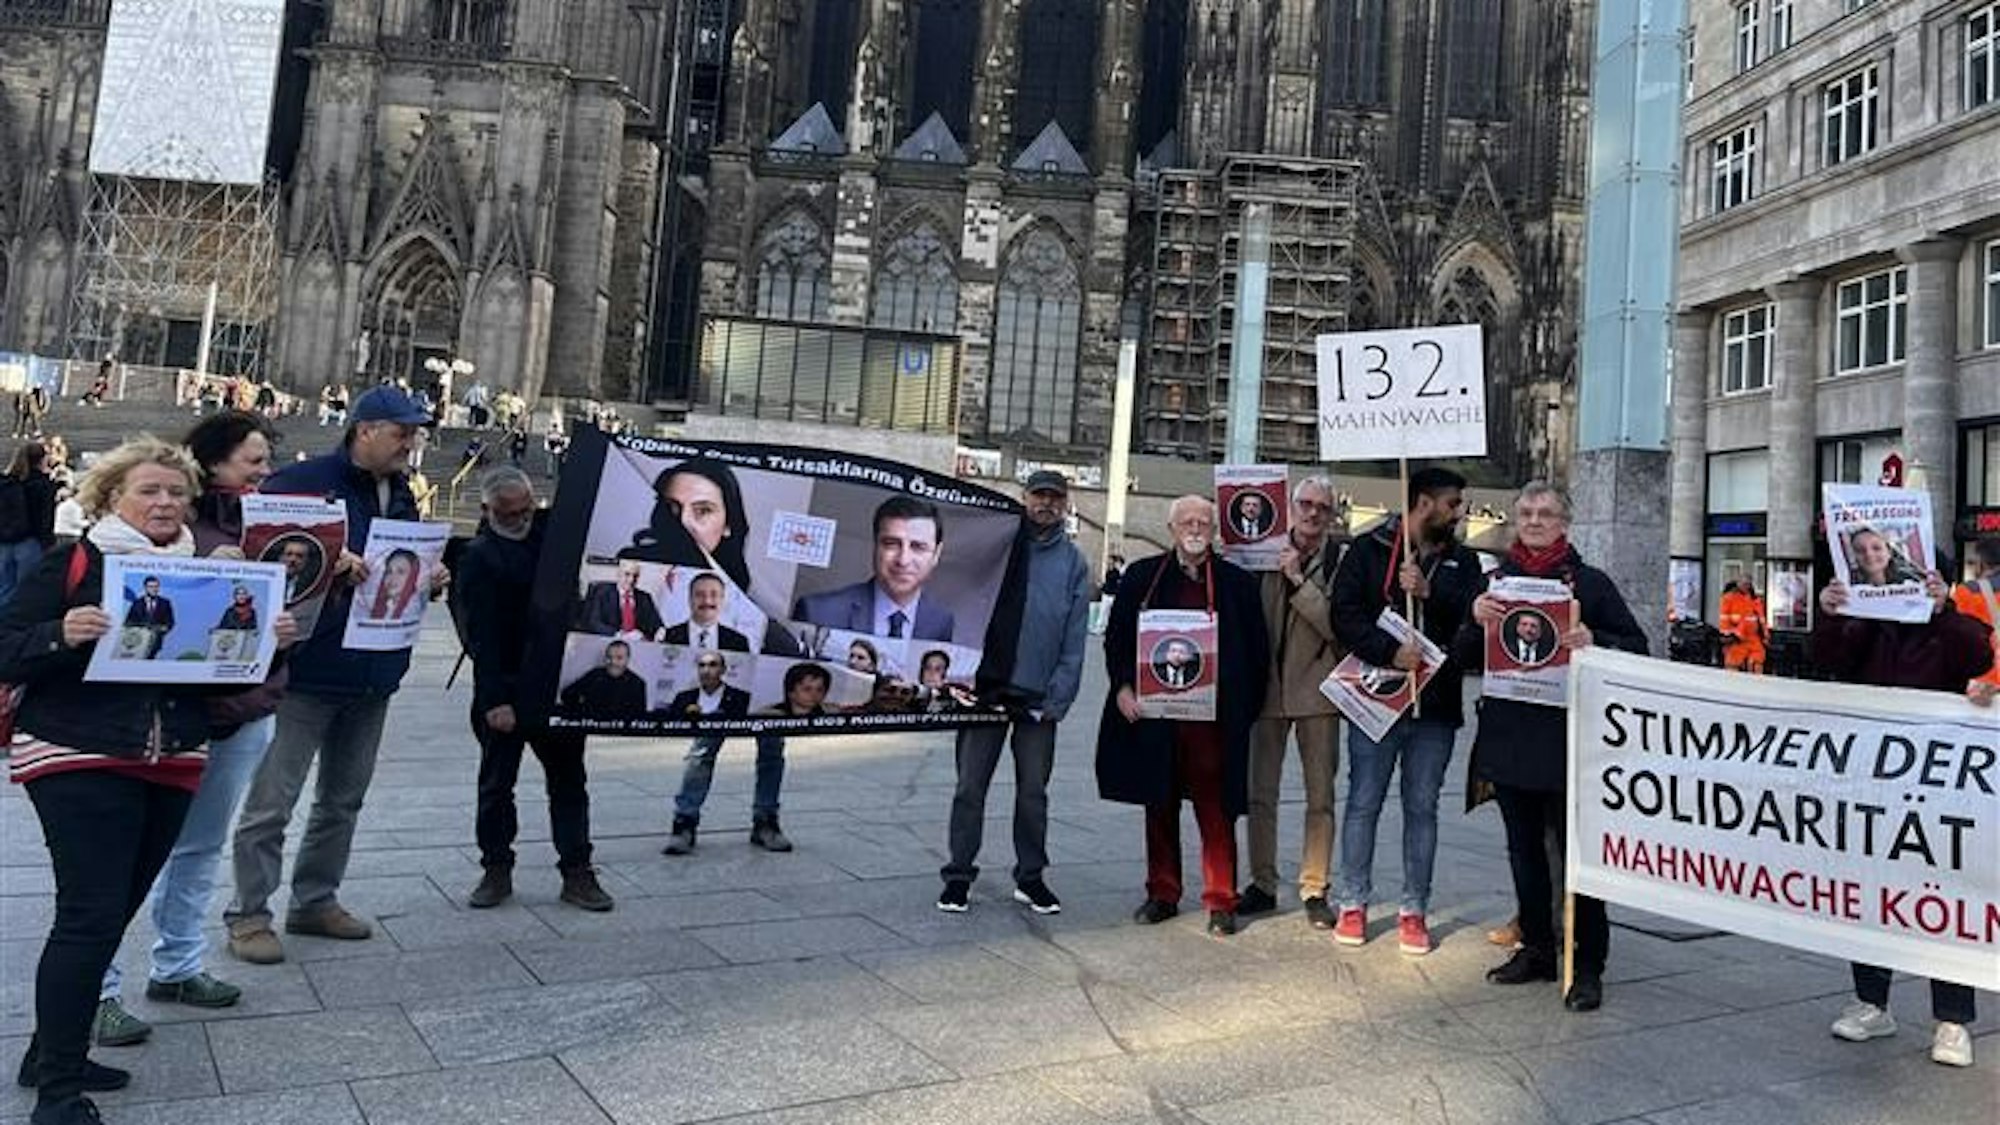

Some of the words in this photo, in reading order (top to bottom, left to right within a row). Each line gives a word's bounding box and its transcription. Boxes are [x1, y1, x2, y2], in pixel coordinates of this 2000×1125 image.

[1335, 340, 1468, 402] 132.
[1322, 405, 1483, 431] MAHNWACHE
[1834, 507, 1921, 523] FREILASSUNG
[1602, 702, 1857, 774] STIMMEN
[1872, 734, 1998, 795] DER
[1601, 765, 1975, 871] SOLIDARITÄT
[1602, 832, 1861, 920] MAHNWACHE
